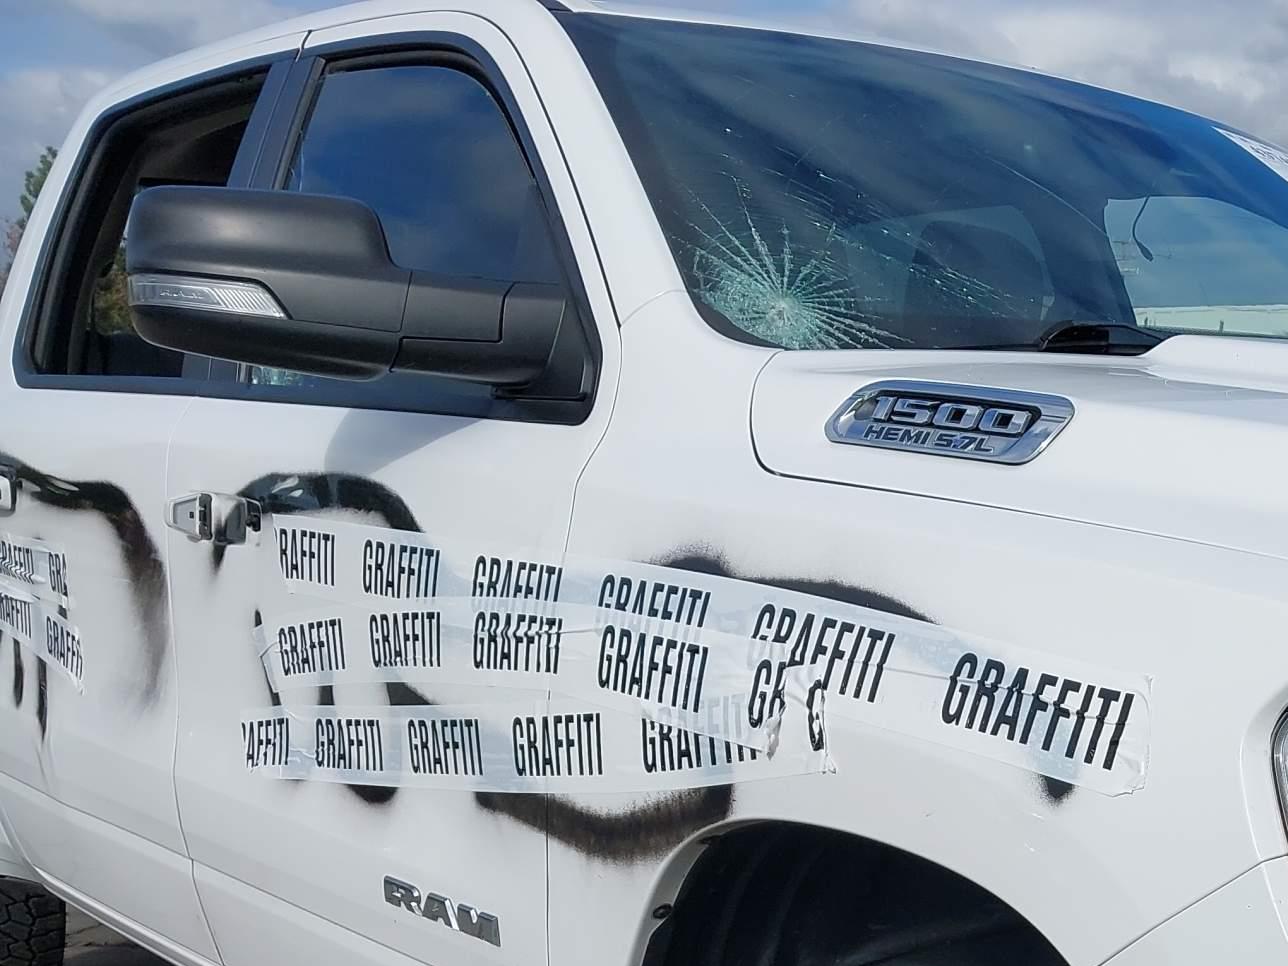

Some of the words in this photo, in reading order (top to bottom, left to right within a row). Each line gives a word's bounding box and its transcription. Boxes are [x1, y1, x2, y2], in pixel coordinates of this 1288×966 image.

[863, 424, 931, 445] HEMI
[871, 395, 1031, 435] 1500
[273, 527, 336, 587] RAFFITI
[361, 538, 441, 600] GRAFFITI
[471, 555, 564, 603] GRAFFITI
[941, 652, 1136, 771] GRAFFITI
[277, 617, 346, 677] GRAFFITI
[369, 610, 441, 668] GRAFFITI
[472, 611, 564, 675] GRAFFITI
[597, 624, 710, 714] GRAFFITI
[241, 717, 290, 769] AFFITI
[315, 717, 384, 772] GRAFFITI
[407, 717, 484, 776] GRAFFITI
[511, 712, 604, 777] GRAFFITI
[383, 875, 501, 948] RAM
